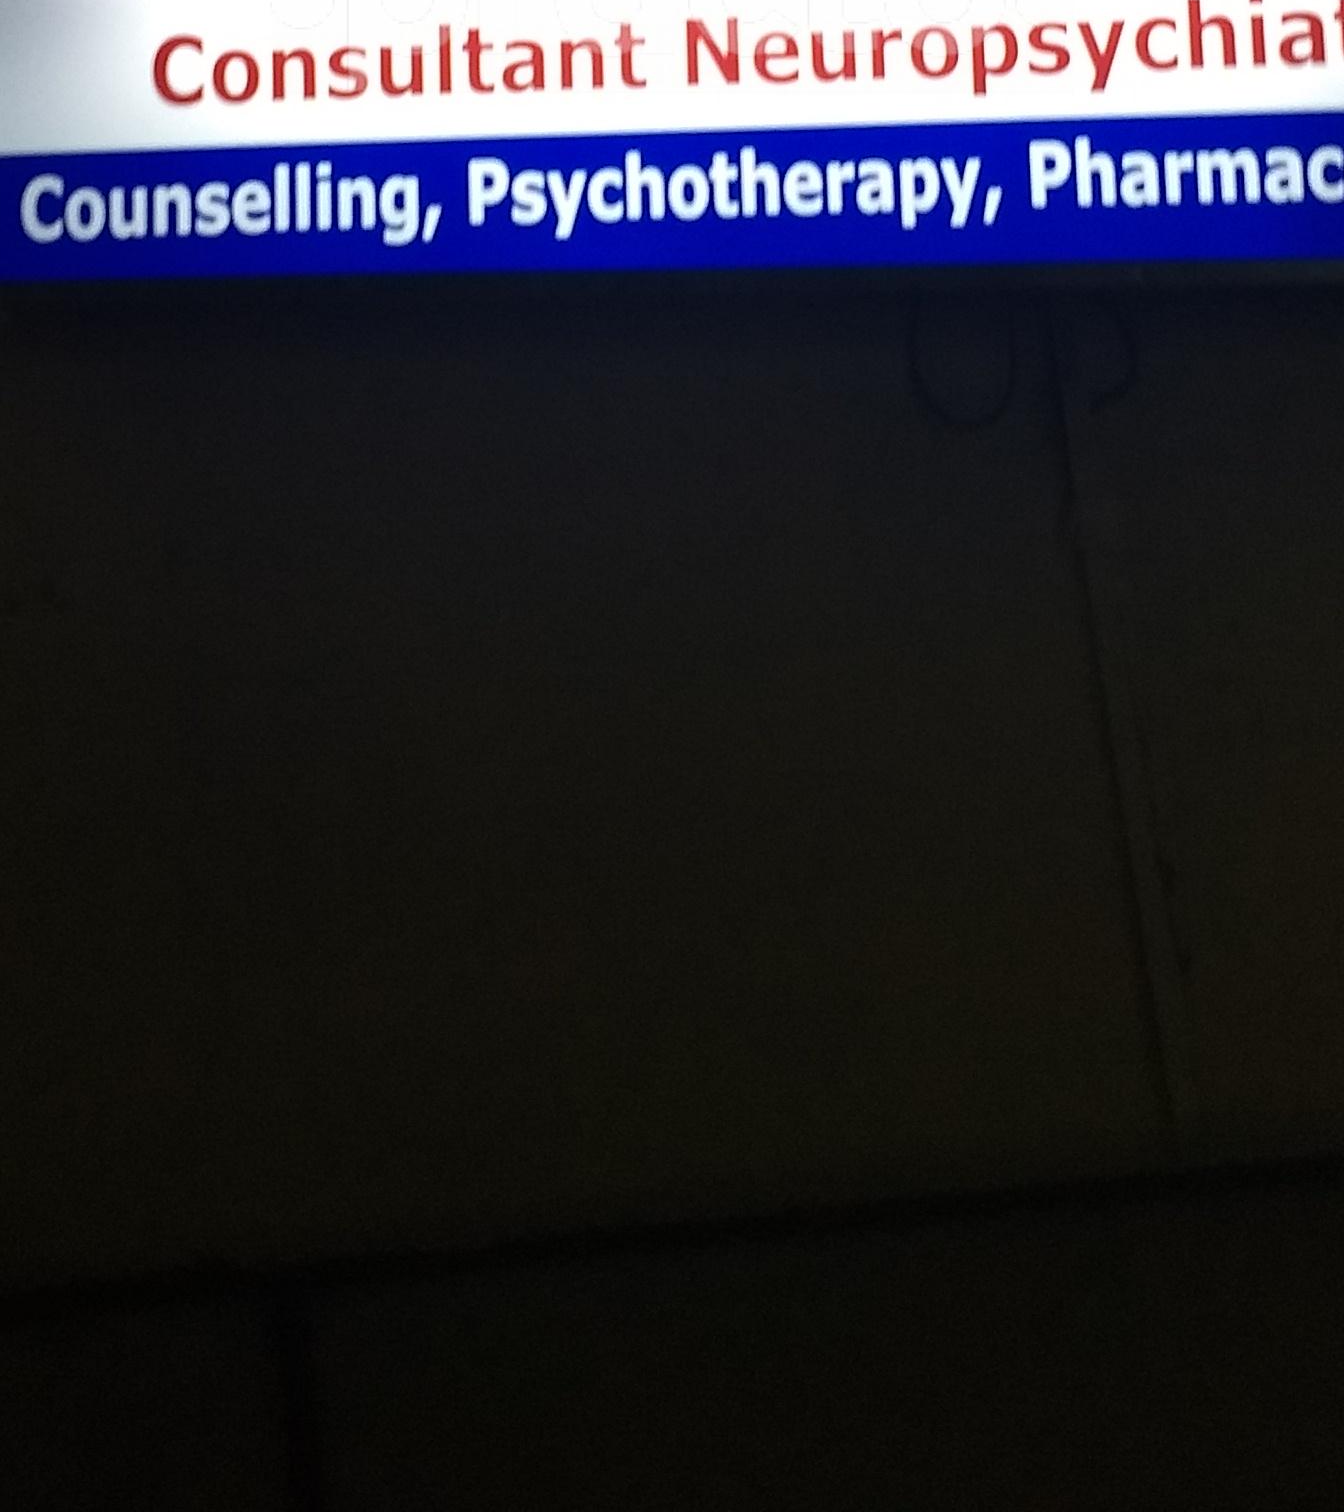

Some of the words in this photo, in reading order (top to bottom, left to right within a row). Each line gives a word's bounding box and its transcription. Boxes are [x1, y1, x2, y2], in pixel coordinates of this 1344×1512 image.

[151, 21, 648, 107] Consultant
[20, 162, 442, 248] Counselling,
[467, 144, 1004, 237] Psychotherapy,
